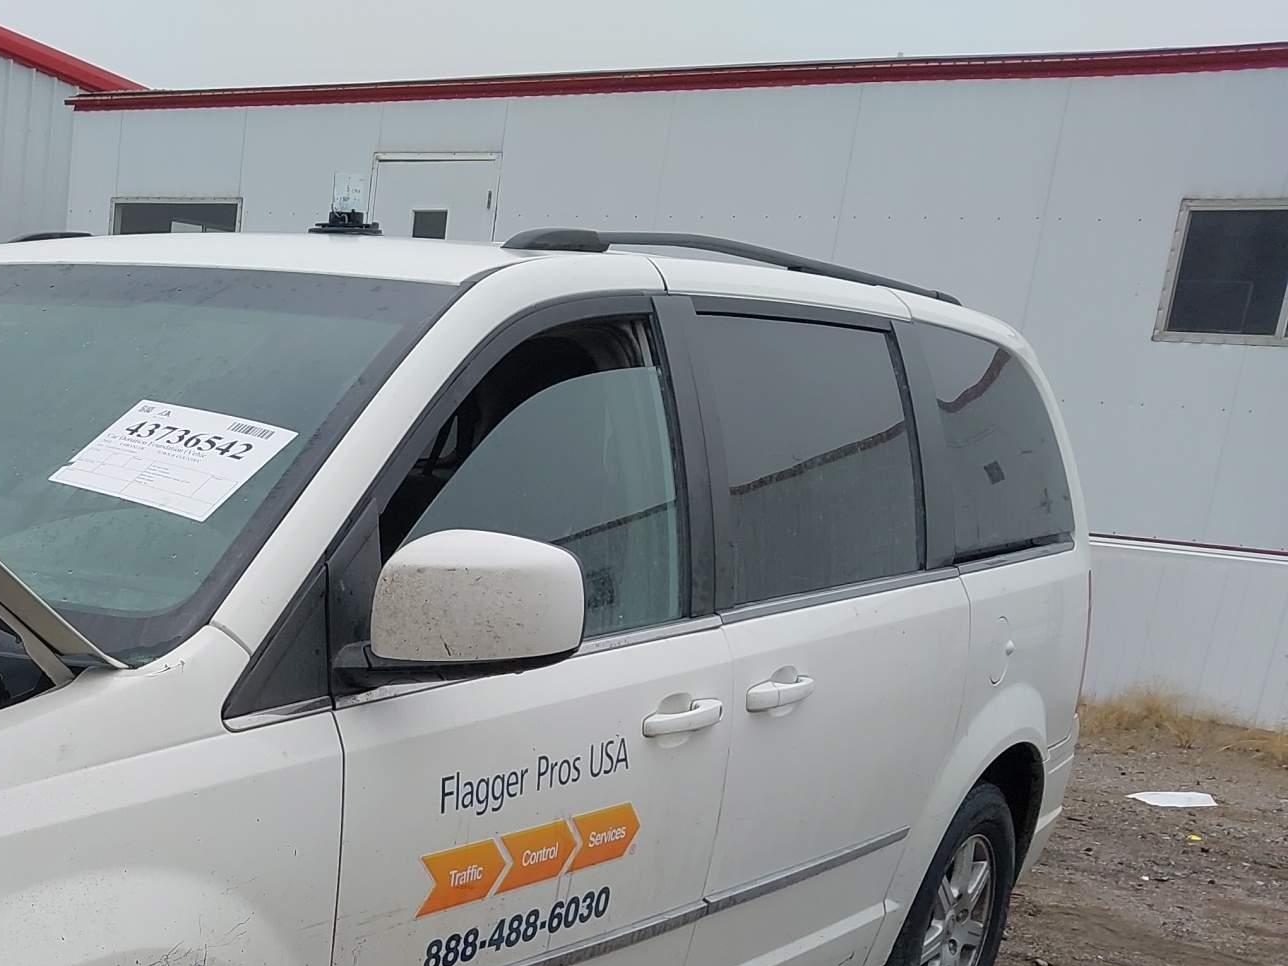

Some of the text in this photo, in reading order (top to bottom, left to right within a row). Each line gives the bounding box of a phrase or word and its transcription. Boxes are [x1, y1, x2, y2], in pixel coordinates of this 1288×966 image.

[125, 420, 253, 460] 43736542
[440, 737, 629, 815] Flagger Pros USA
[449, 826, 627, 887] Traffic Control Services
